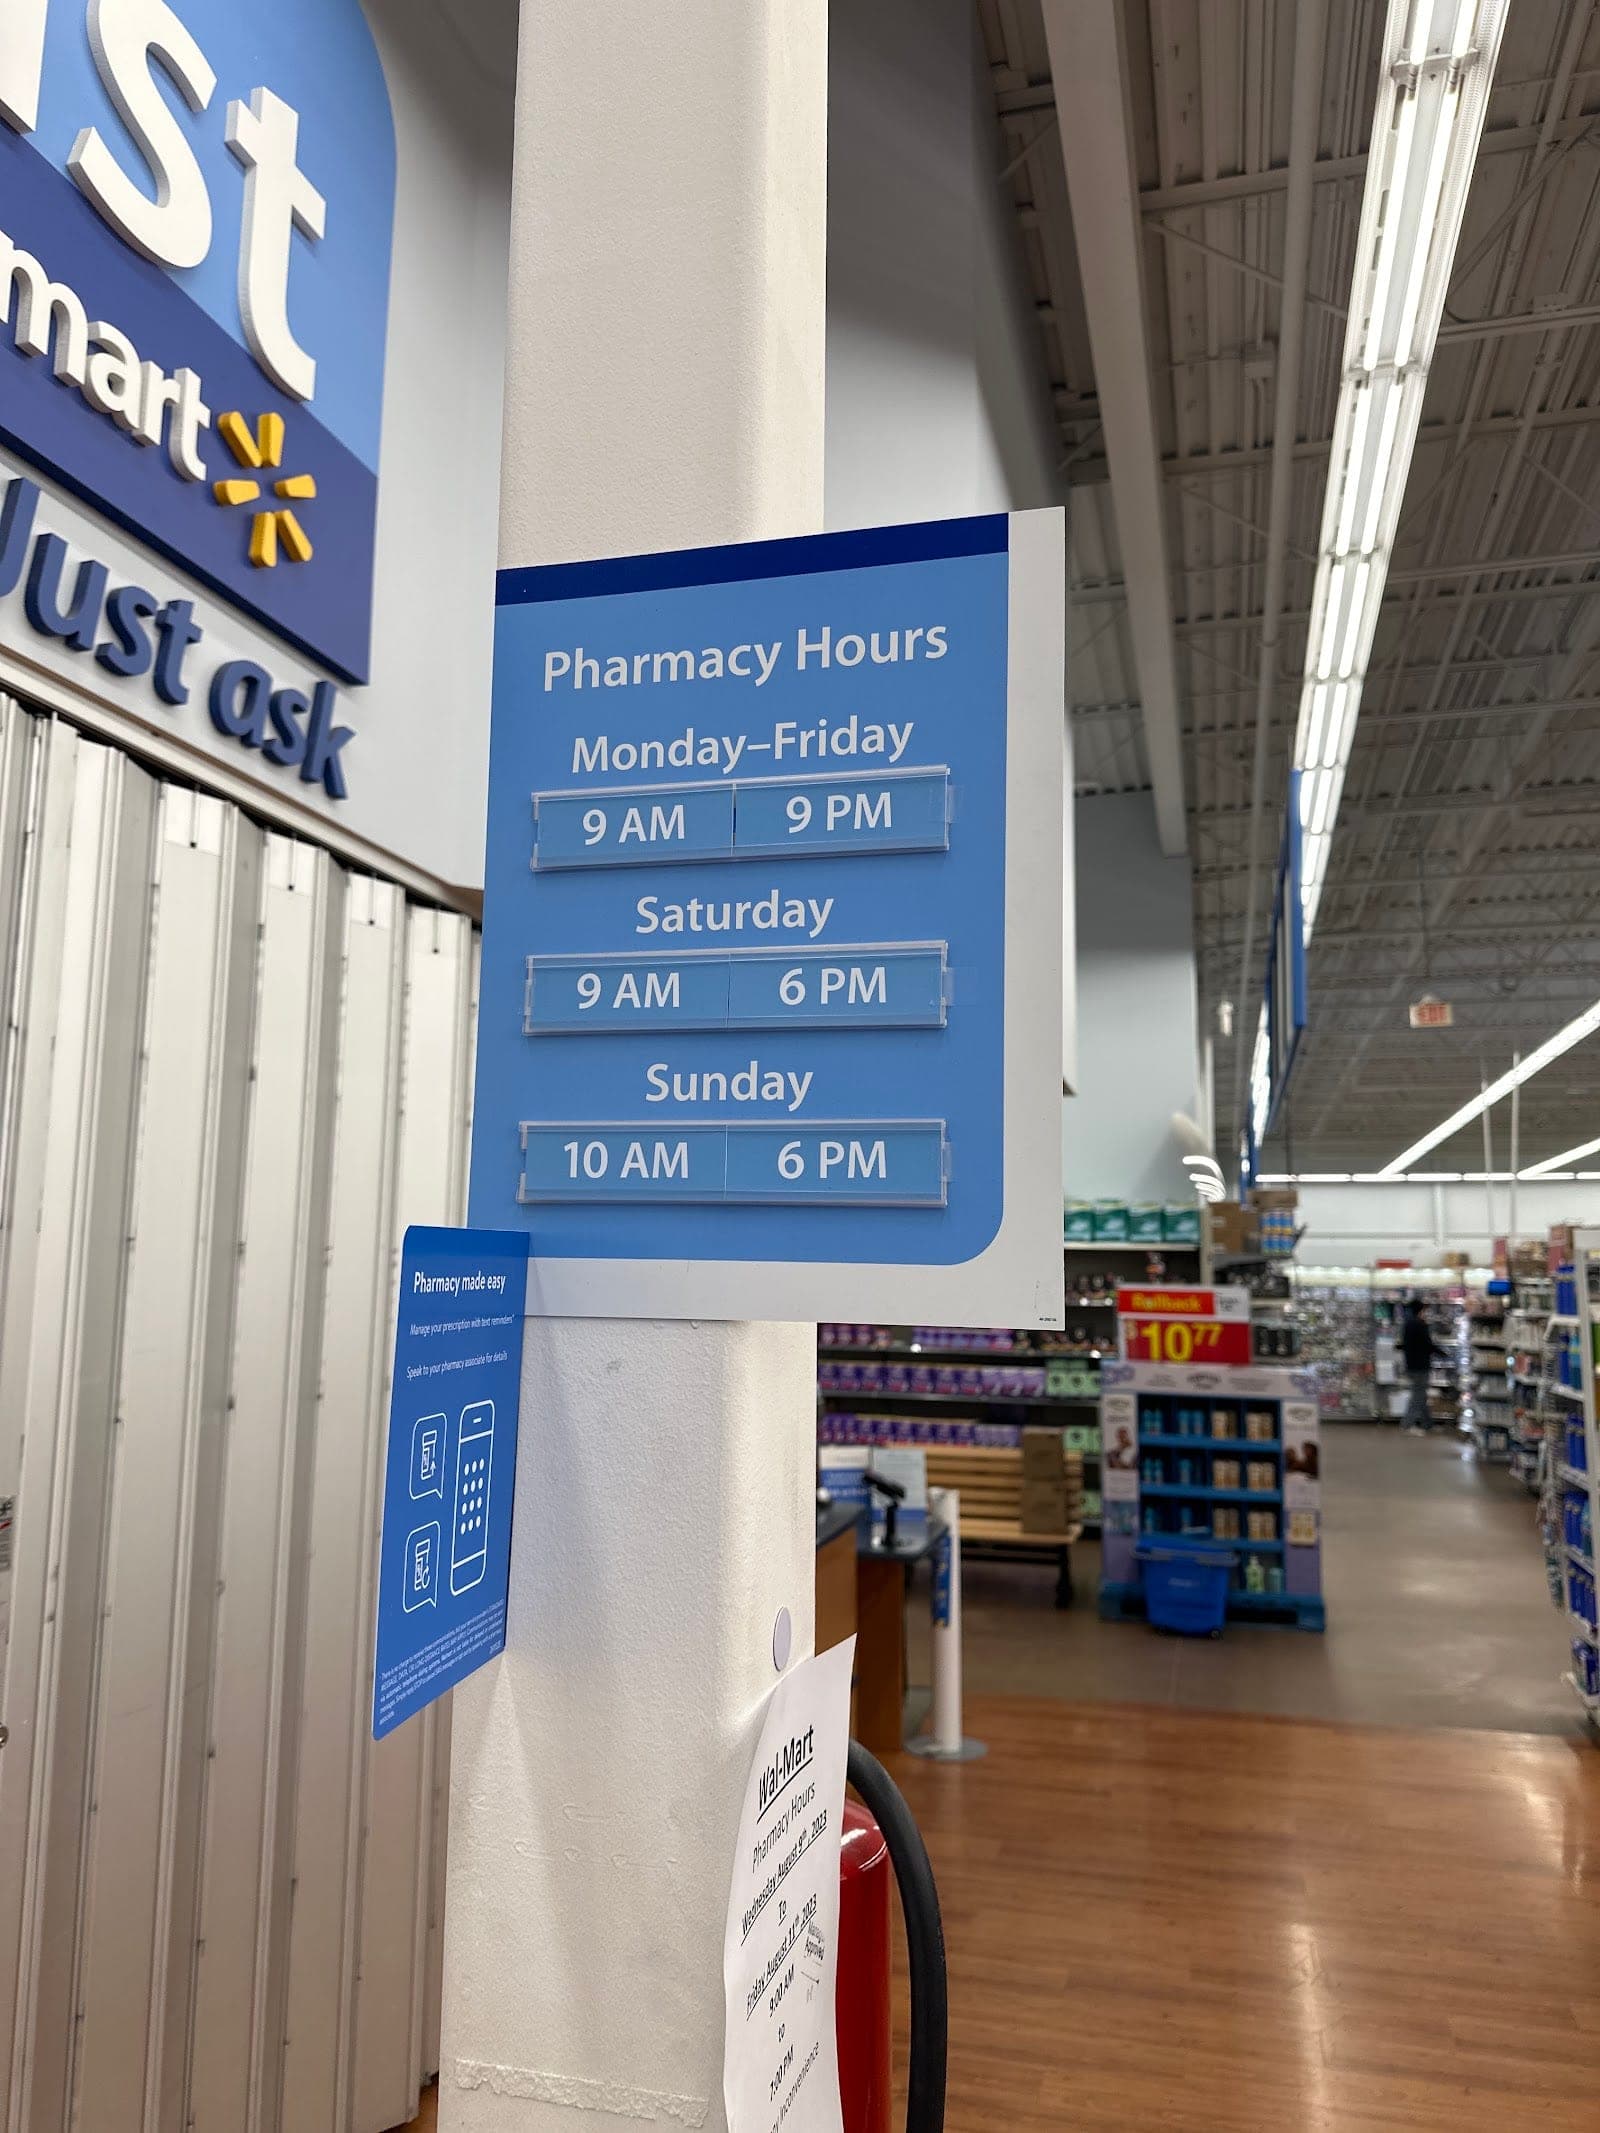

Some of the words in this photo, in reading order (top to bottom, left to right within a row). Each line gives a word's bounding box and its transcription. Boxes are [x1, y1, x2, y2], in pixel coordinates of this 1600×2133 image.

[0, 477, 202, 706] Just
[208, 660, 357, 800] ask
[544, 642, 782, 692] Pharmacy
[797, 624, 948, 671] Hours
[583, 808, 607, 846] 9
[619, 805, 685, 843] AM
[786, 796, 812, 834] 9
[826, 792, 892, 832] PM
[636, 888, 834, 938] Saturday
[576, 972, 601, 1009] 9
[613, 972, 680, 1008] AM
[779, 968, 806, 1005] 6
[821, 967, 887, 1004] PM
[646, 1061, 814, 1112] Sunday
[563, 1141, 608, 1179] 10
[620, 1141, 689, 1179] AM
[777, 1141, 804, 1179] 6
[820, 1141, 887, 1179] PM
[413, 1271, 460, 1297] Pharmacy
[462, 1270, 485, 1291] made
[487, 1275, 506, 1294] easy
[410, 1323, 431, 1337] Manage
[431, 1322, 442, 1336] your
[442, 1318, 471, 1335] prescription
[406, 1364, 422, 1381] Speak
[422, 1365, 429, 1376] to
[429, 1363, 441, 1378] your
[441, 1360, 465, 1375] pharmacy
[758, 1724, 814, 1812] Wal-Mart
[752, 1809, 790, 1874] Pharmacy
[791, 1782, 815, 1821] Hours
[742, 1873, 776, 1935] Wednesday
[778, 1843, 798, 1883] August
[811, 1808, 827, 1839] 2023
[778, 1900, 787, 1922] To
[746, 1974, 766, 2015] Friday
[766, 1936, 787, 1980] August
[783, 1963, 795, 1994] AM
[778, 2023, 785, 2043] to
[783, 2044, 793, 2076] PM
